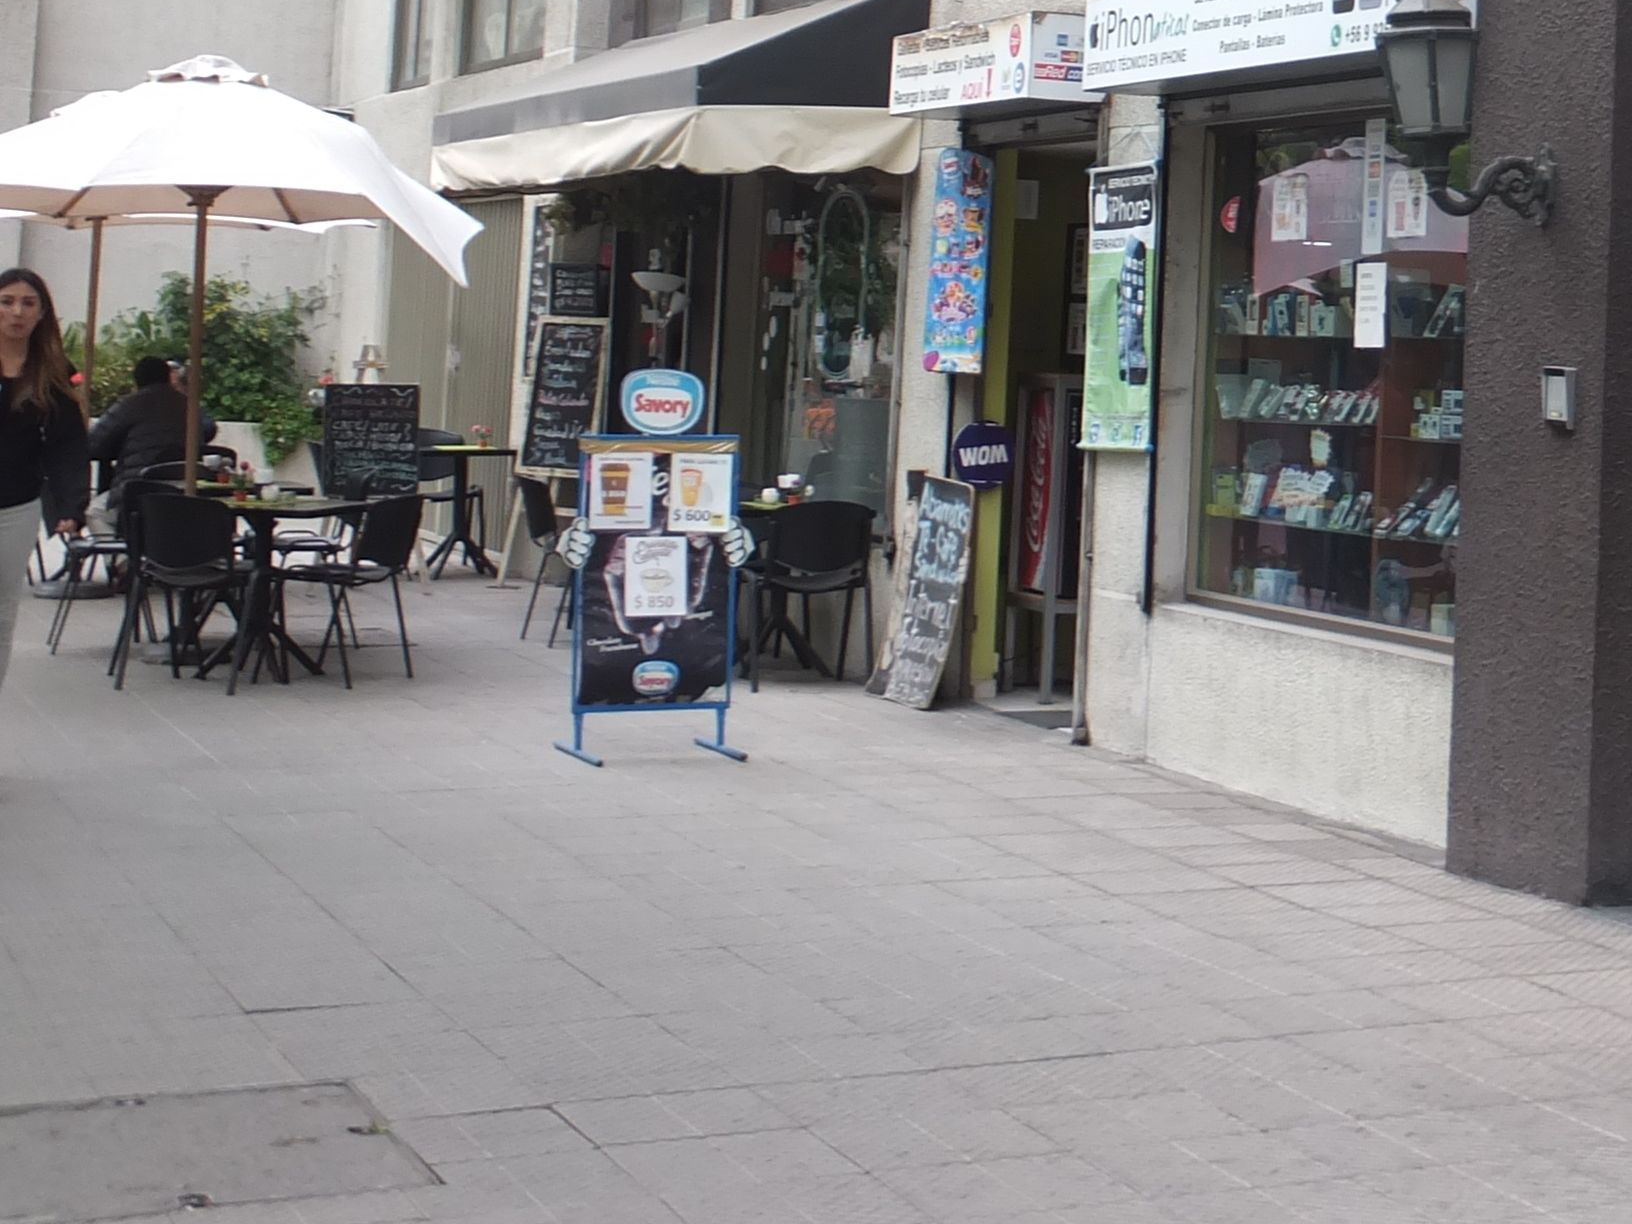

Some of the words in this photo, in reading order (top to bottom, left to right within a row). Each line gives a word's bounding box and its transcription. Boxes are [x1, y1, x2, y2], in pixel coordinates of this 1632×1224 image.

[1193, 18, 1221, 32] Conector
[1223, 16, 1231, 27] de
[1233, 14, 1252, 28] carga
[1285, 1, 1324, 18] Protectora
[1219, 38, 1250, 53] Pantallas
[1108, 195, 1151, 223] iPhone
[635, 393, 690, 418] Savory
[958, 444, 1009, 467] WOM
[673, 509, 681, 522] $
[686, 509, 712, 522] 600
[634, 595, 643, 610] $
[647, 595, 675, 609] 850
